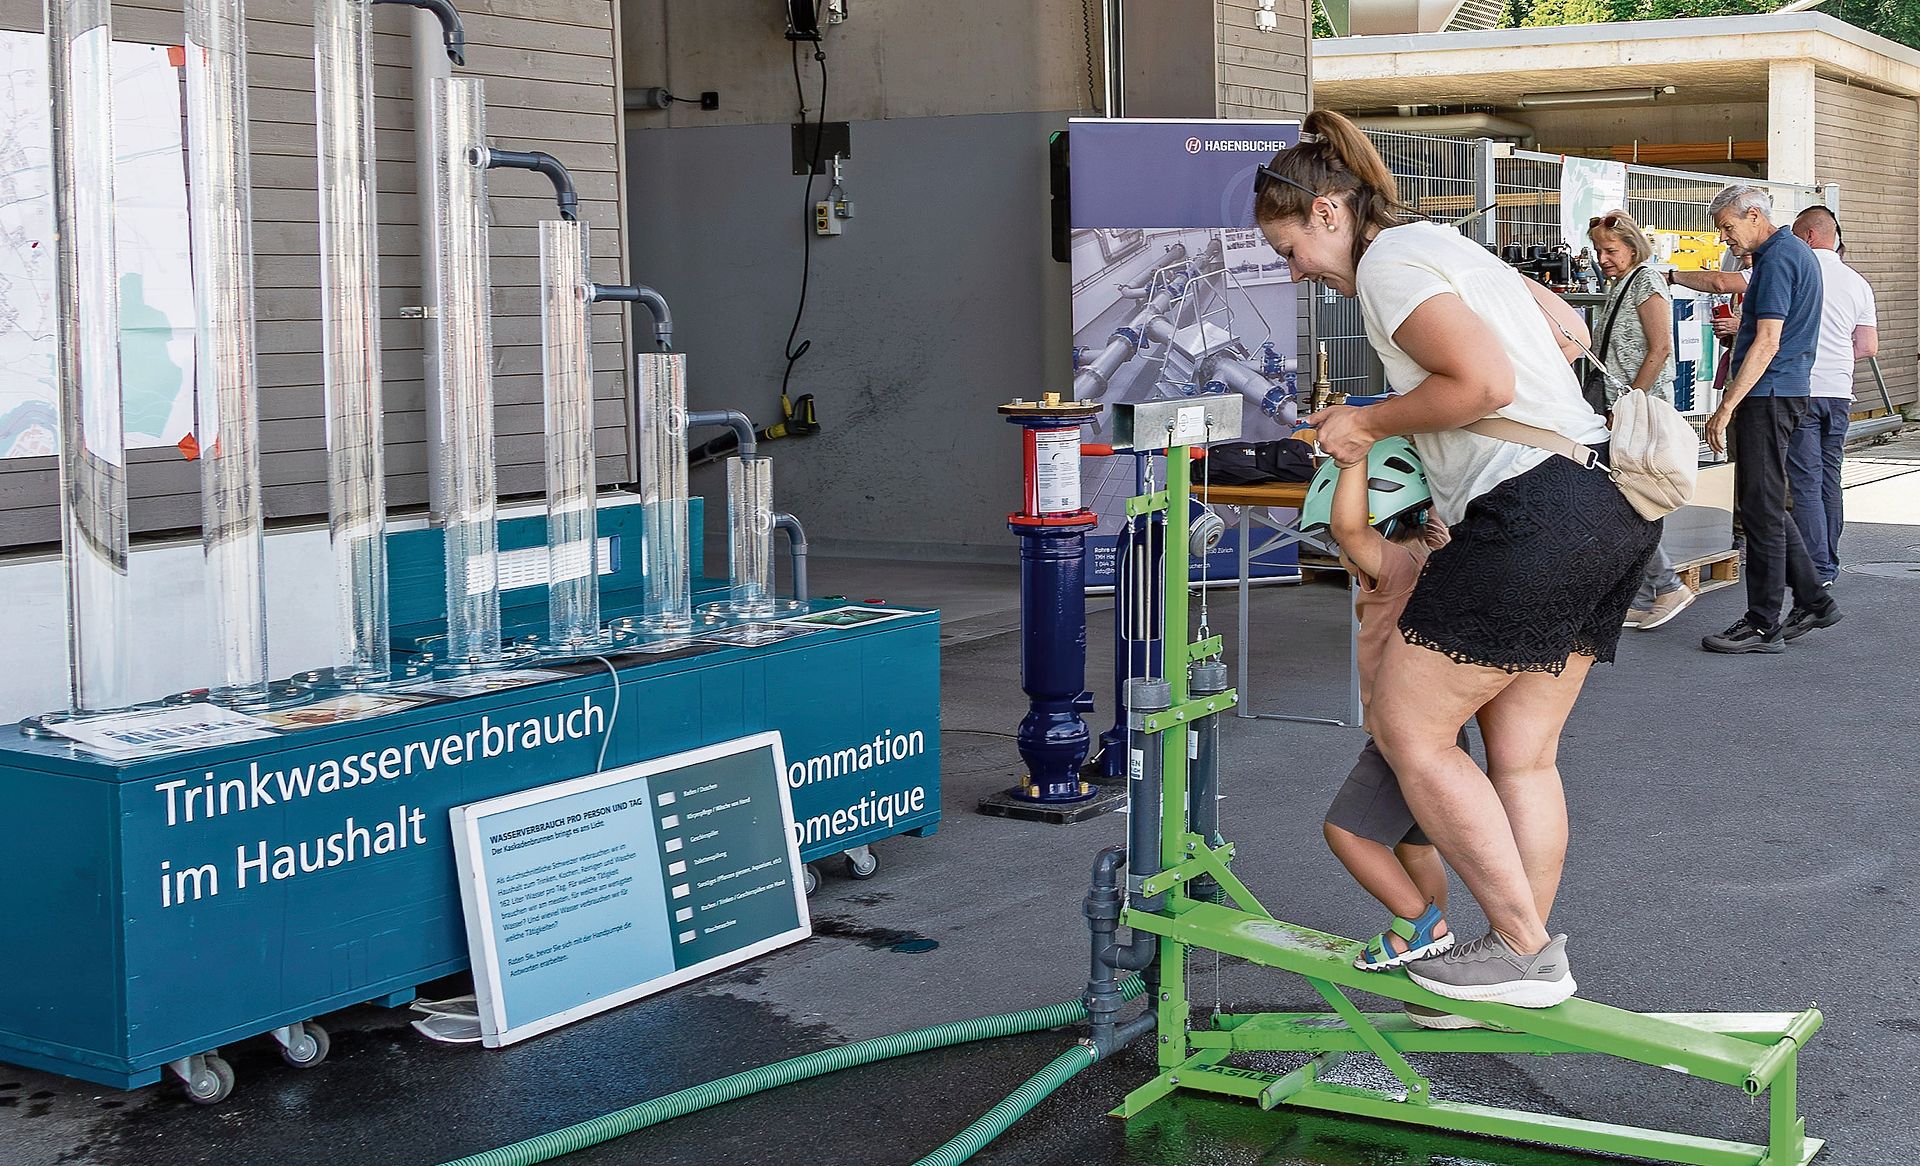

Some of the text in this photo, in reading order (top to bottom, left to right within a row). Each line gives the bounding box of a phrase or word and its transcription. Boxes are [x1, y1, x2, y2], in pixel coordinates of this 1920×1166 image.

[1205, 140, 1286, 152] HAGENBUCHER
[155, 696, 606, 825] Trinkwasserverbrauch
[788, 729, 924, 788] ommation
[490, 797, 642, 843] WASSERVERBRAUCH PRO PERSON UND TAG
[794, 786, 925, 847] omestique
[162, 805, 427, 908] im Haushalt
[504, 834, 554, 851] Kaskadenbrunnen
[555, 828, 572, 838] bringt
[579, 848, 609, 861] verbrauchen
[498, 883, 522, 896] Haushalt
[559, 869, 580, 878] Kochen,
[603, 857, 614, 866] und
[615, 852, 636, 863] Waschen
[511, 896, 524, 904] Liter
[525, 890, 544, 900] Wasser
[545, 887, 554, 896] pro
[578, 875, 596, 885] welche
[501, 907, 527, 918] brauchen
[528, 903, 537, 911] wir
[580, 886, 597, 896] welche
[608, 876, 632, 888] wenigsten
[503, 917, 527, 930] Wasser?
[528, 914, 539, 923] Und
[560, 903, 579, 913] Wasser
[580, 894, 610, 907] verbrauchen
[505, 920, 558, 942] welche Tätigkeiten?
[508, 956, 524, 965] Raten
[536, 947, 552, 956] bevor
[562, 939, 572, 948] sich
[573, 936, 582, 945] mit
[592, 925, 623, 939] Handpumpe
[510, 963, 539, 976] Antworten
